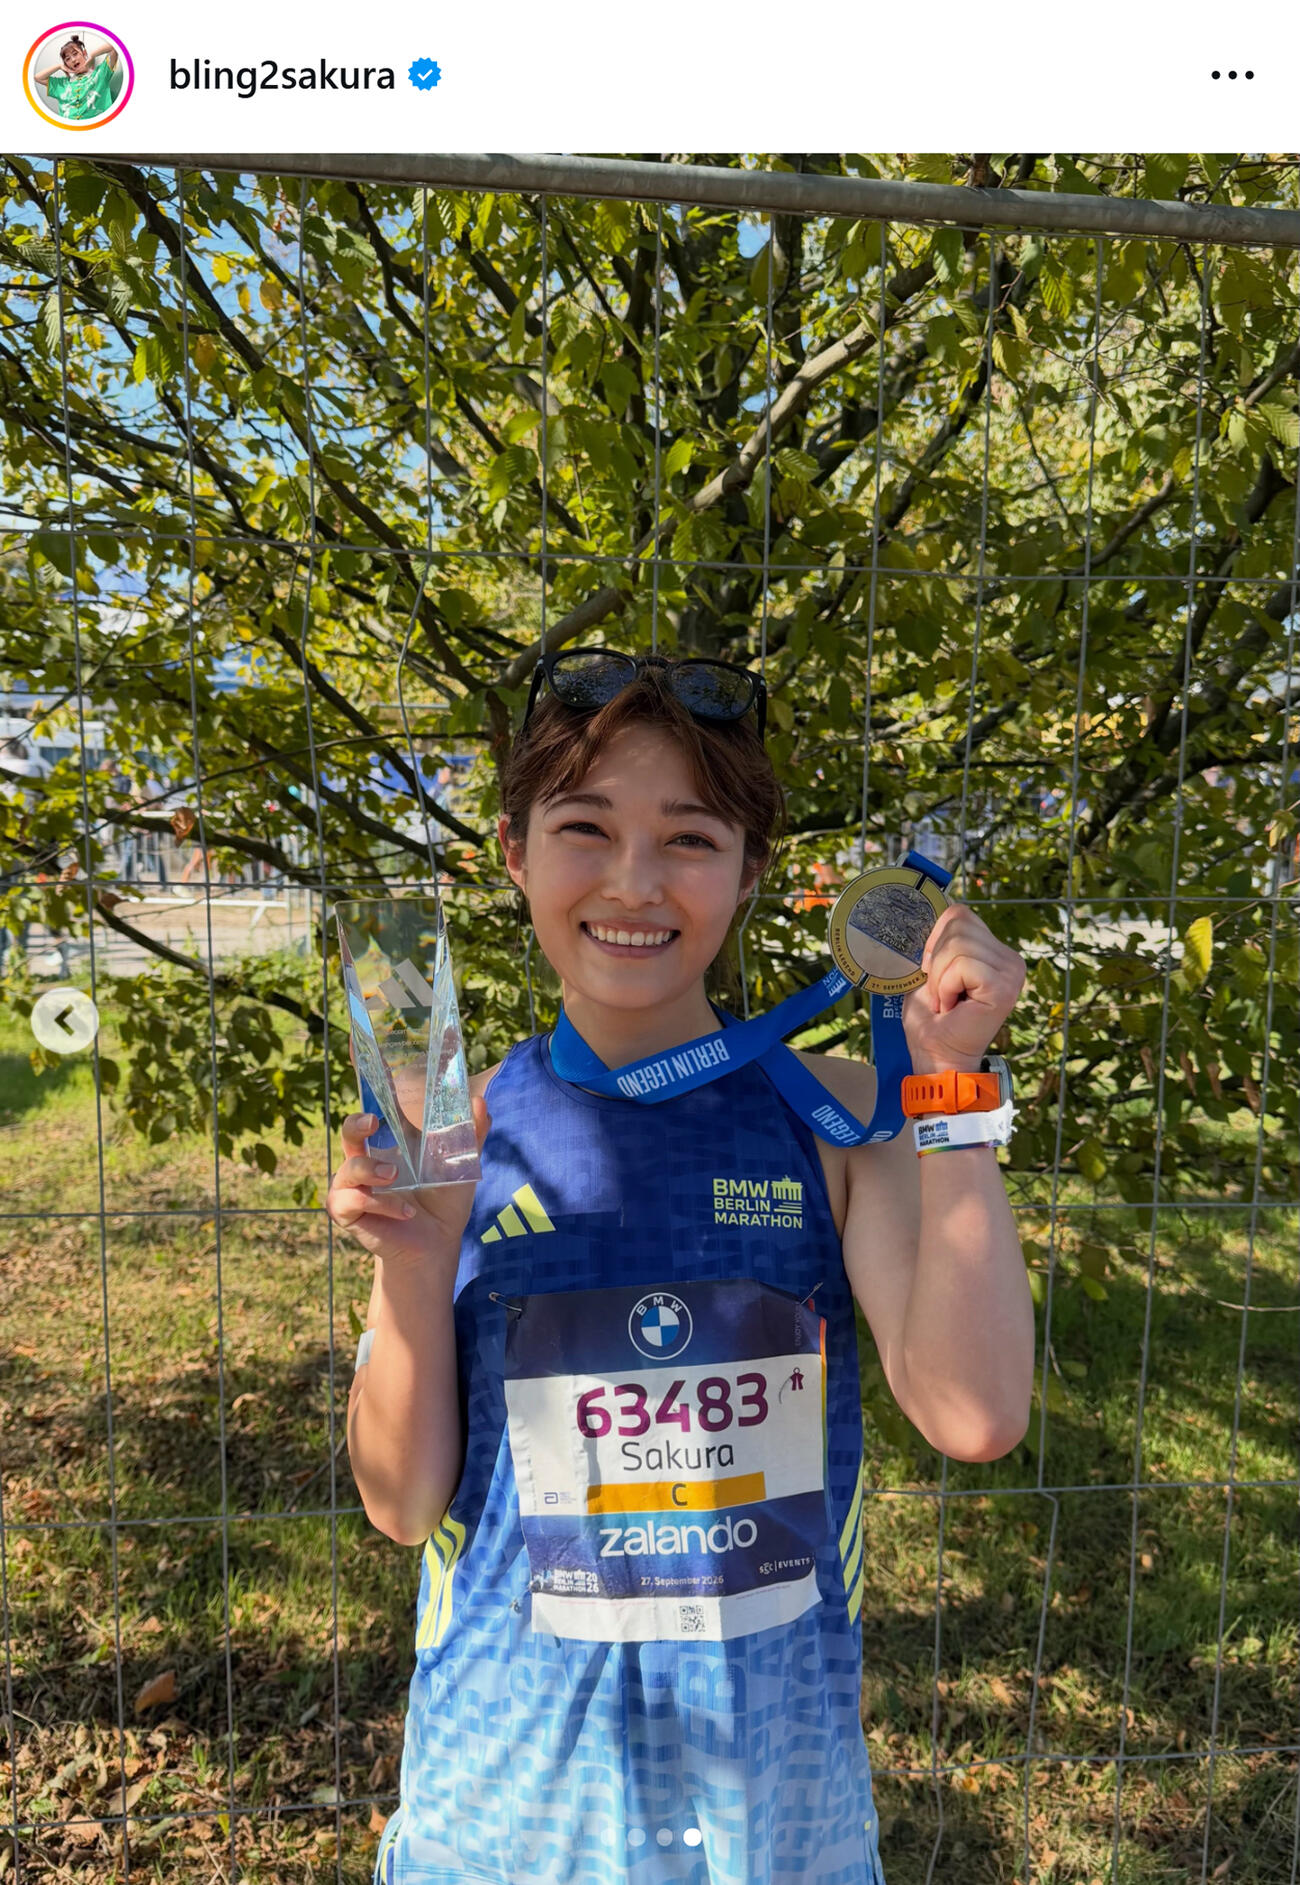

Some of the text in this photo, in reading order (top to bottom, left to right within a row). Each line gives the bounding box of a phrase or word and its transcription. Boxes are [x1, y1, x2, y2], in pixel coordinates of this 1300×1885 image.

[883, 995, 894, 1018] BM
[617, 1038, 731, 1098] BERLIN LEGEND
[811, 1104, 862, 1145] LEGEND
[919, 1124, 934, 1135] BMW
[920, 1137, 949, 1146] MARATHON
[712, 1178, 769, 1199] BMW
[713, 1198, 771, 1213] BERLIN
[714, 1212, 803, 1230] MARATHON
[636, 1296, 683, 1317] BMW
[576, 1372, 769, 1439] 63483
[621, 1440, 735, 1472] Sakura
[671, 1483, 688, 1507] C
[600, 1518, 758, 1558] zalando
[778, 1557, 811, 1569] EVENTS
[586, 1571, 598, 1582] 20
[640, 1575, 724, 1588] 27. September 2026
[586, 1582, 600, 1593] 26
